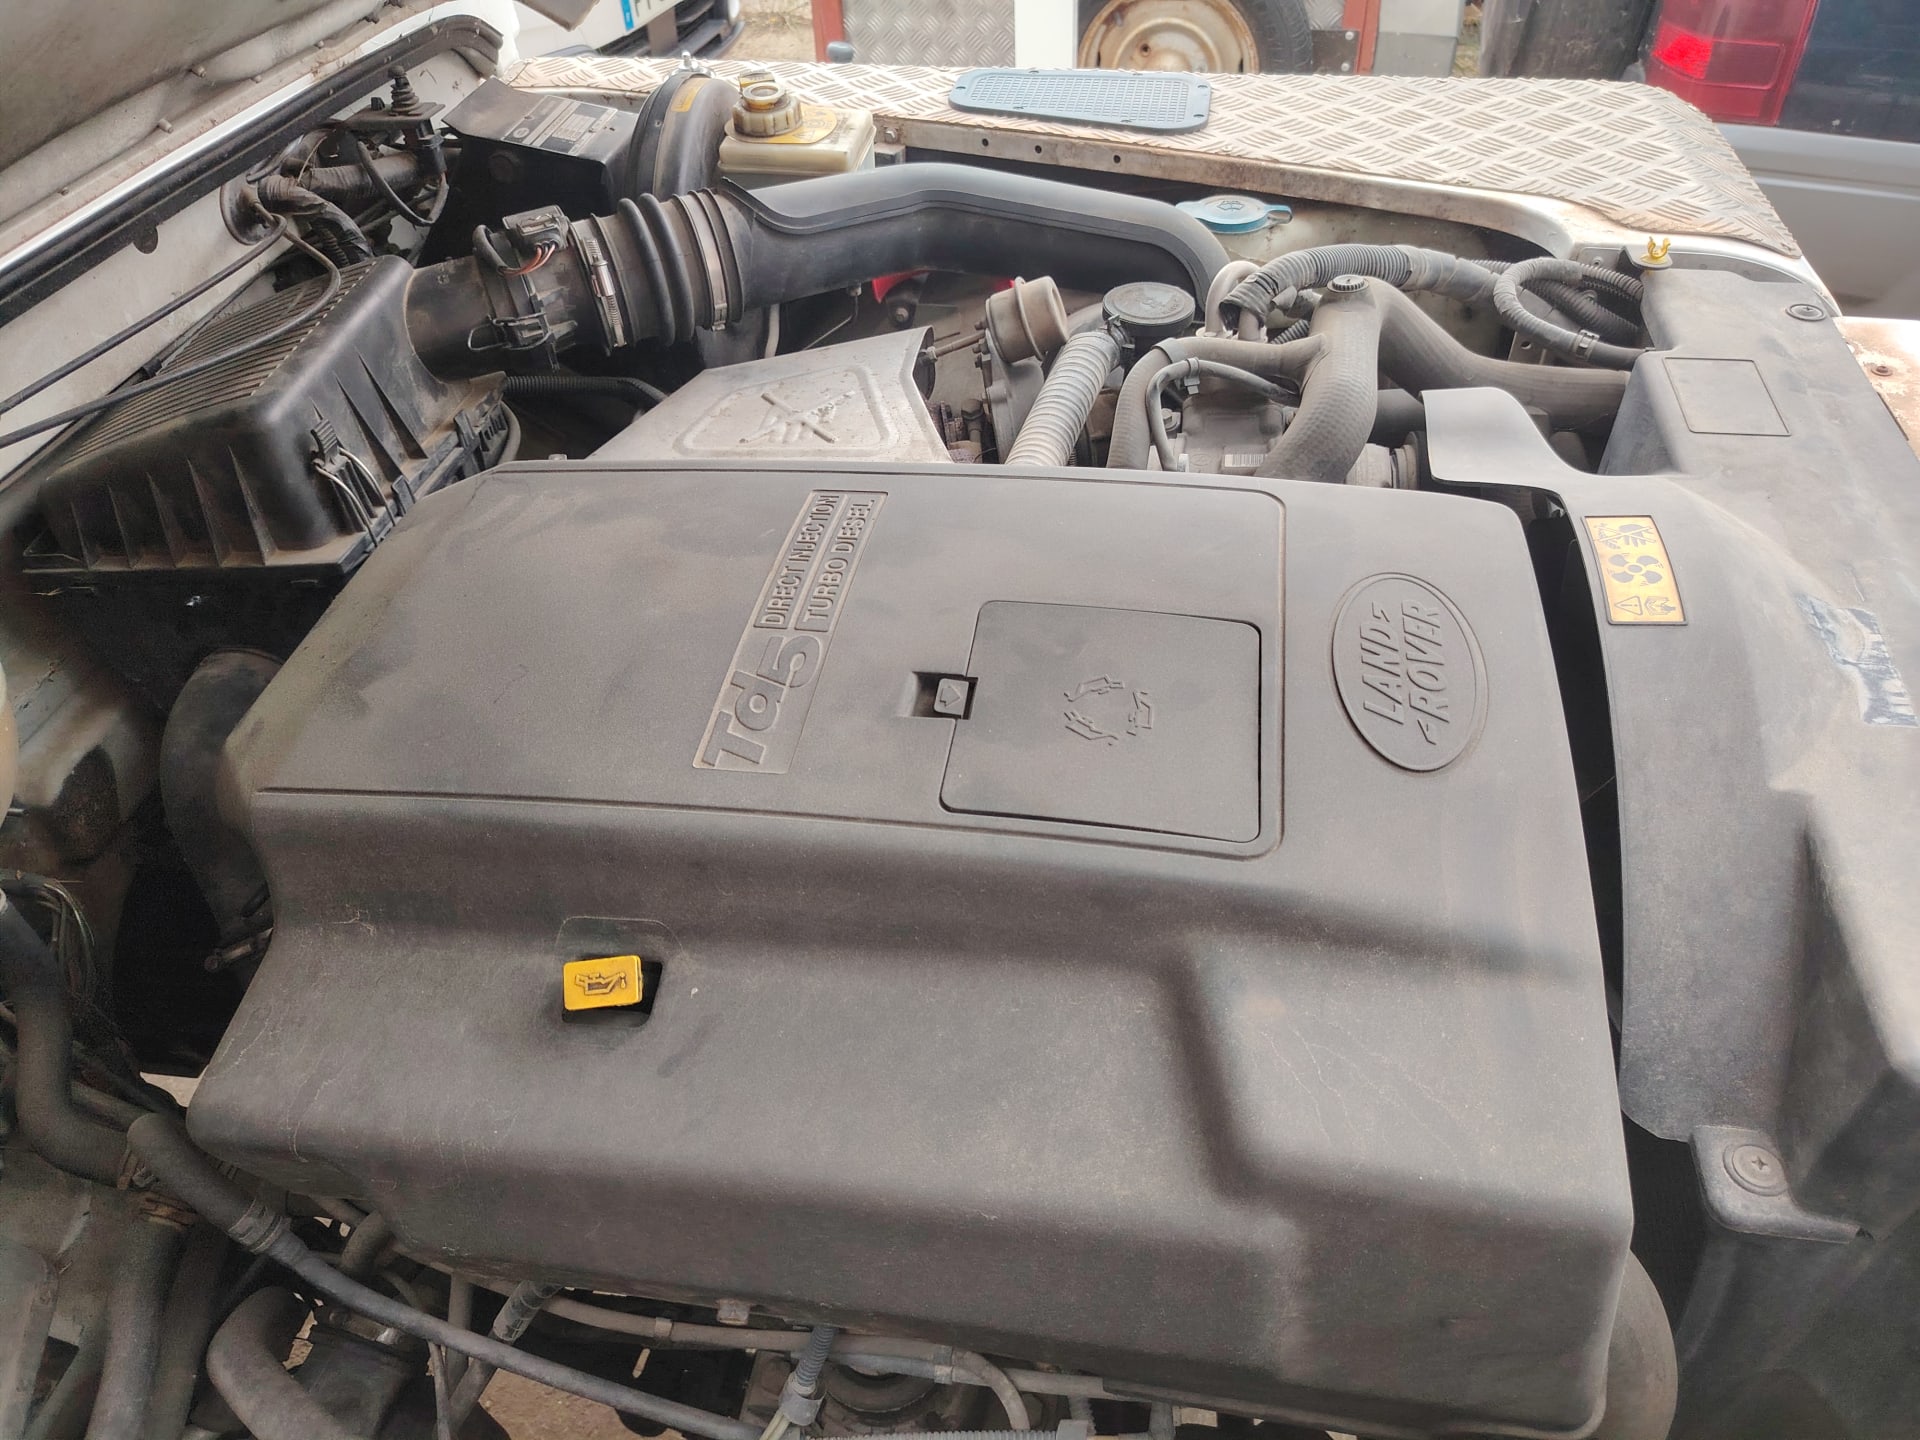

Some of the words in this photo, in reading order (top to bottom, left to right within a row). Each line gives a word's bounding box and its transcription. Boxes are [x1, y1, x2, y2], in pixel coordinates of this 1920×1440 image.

[761, 565, 805, 625] DIRECT
[788, 494, 840, 562] INJECTION
[803, 557, 848, 622] TURBO
[831, 499, 875, 554] DIESEL
[700, 634, 824, 768] Td5
[1360, 623, 1405, 726] LAND
[1401, 600, 1450, 723] ROVER
